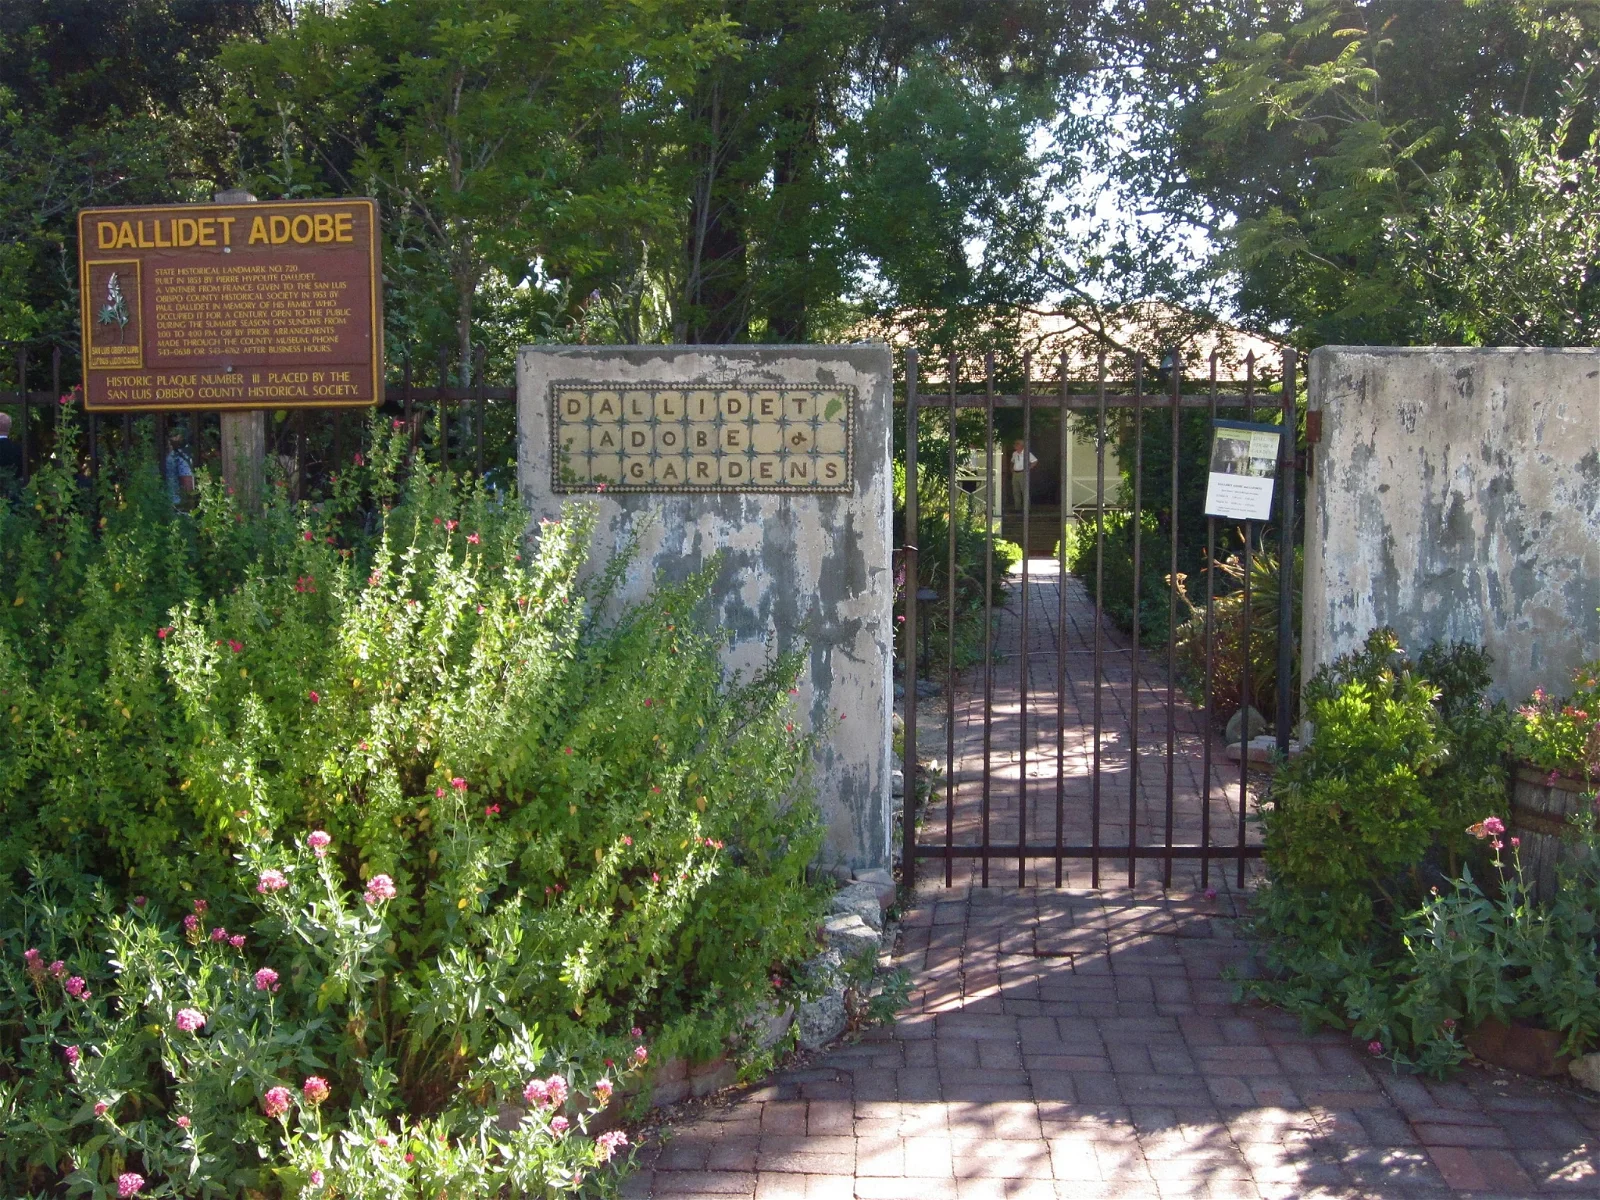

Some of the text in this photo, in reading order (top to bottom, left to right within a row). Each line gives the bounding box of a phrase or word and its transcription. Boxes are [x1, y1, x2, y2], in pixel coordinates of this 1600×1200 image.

[98, 213, 353, 250] DALLIDET ADOBE
[178, 267, 219, 275] HISTORICAL
[221, 292, 263, 301] HISTORICAL
[274, 327, 334, 335] ARRANGEMENTS
[107, 376, 152, 386] HISTORIC
[157, 375, 197, 386] PLAQUE
[201, 374, 244, 385] NUMBER
[268, 372, 308, 383] PLACED
[312, 372, 325, 382] BY
[330, 371, 350, 382] THE
[107, 384, 358, 400] SAN LUIS OBISPO COUNTY HISTORICAL SOCIETY.
[567, 398, 807, 416] DALLIDET
[600, 429, 807, 448] ADOBE &
[630, 462, 837, 479] GARDENS
